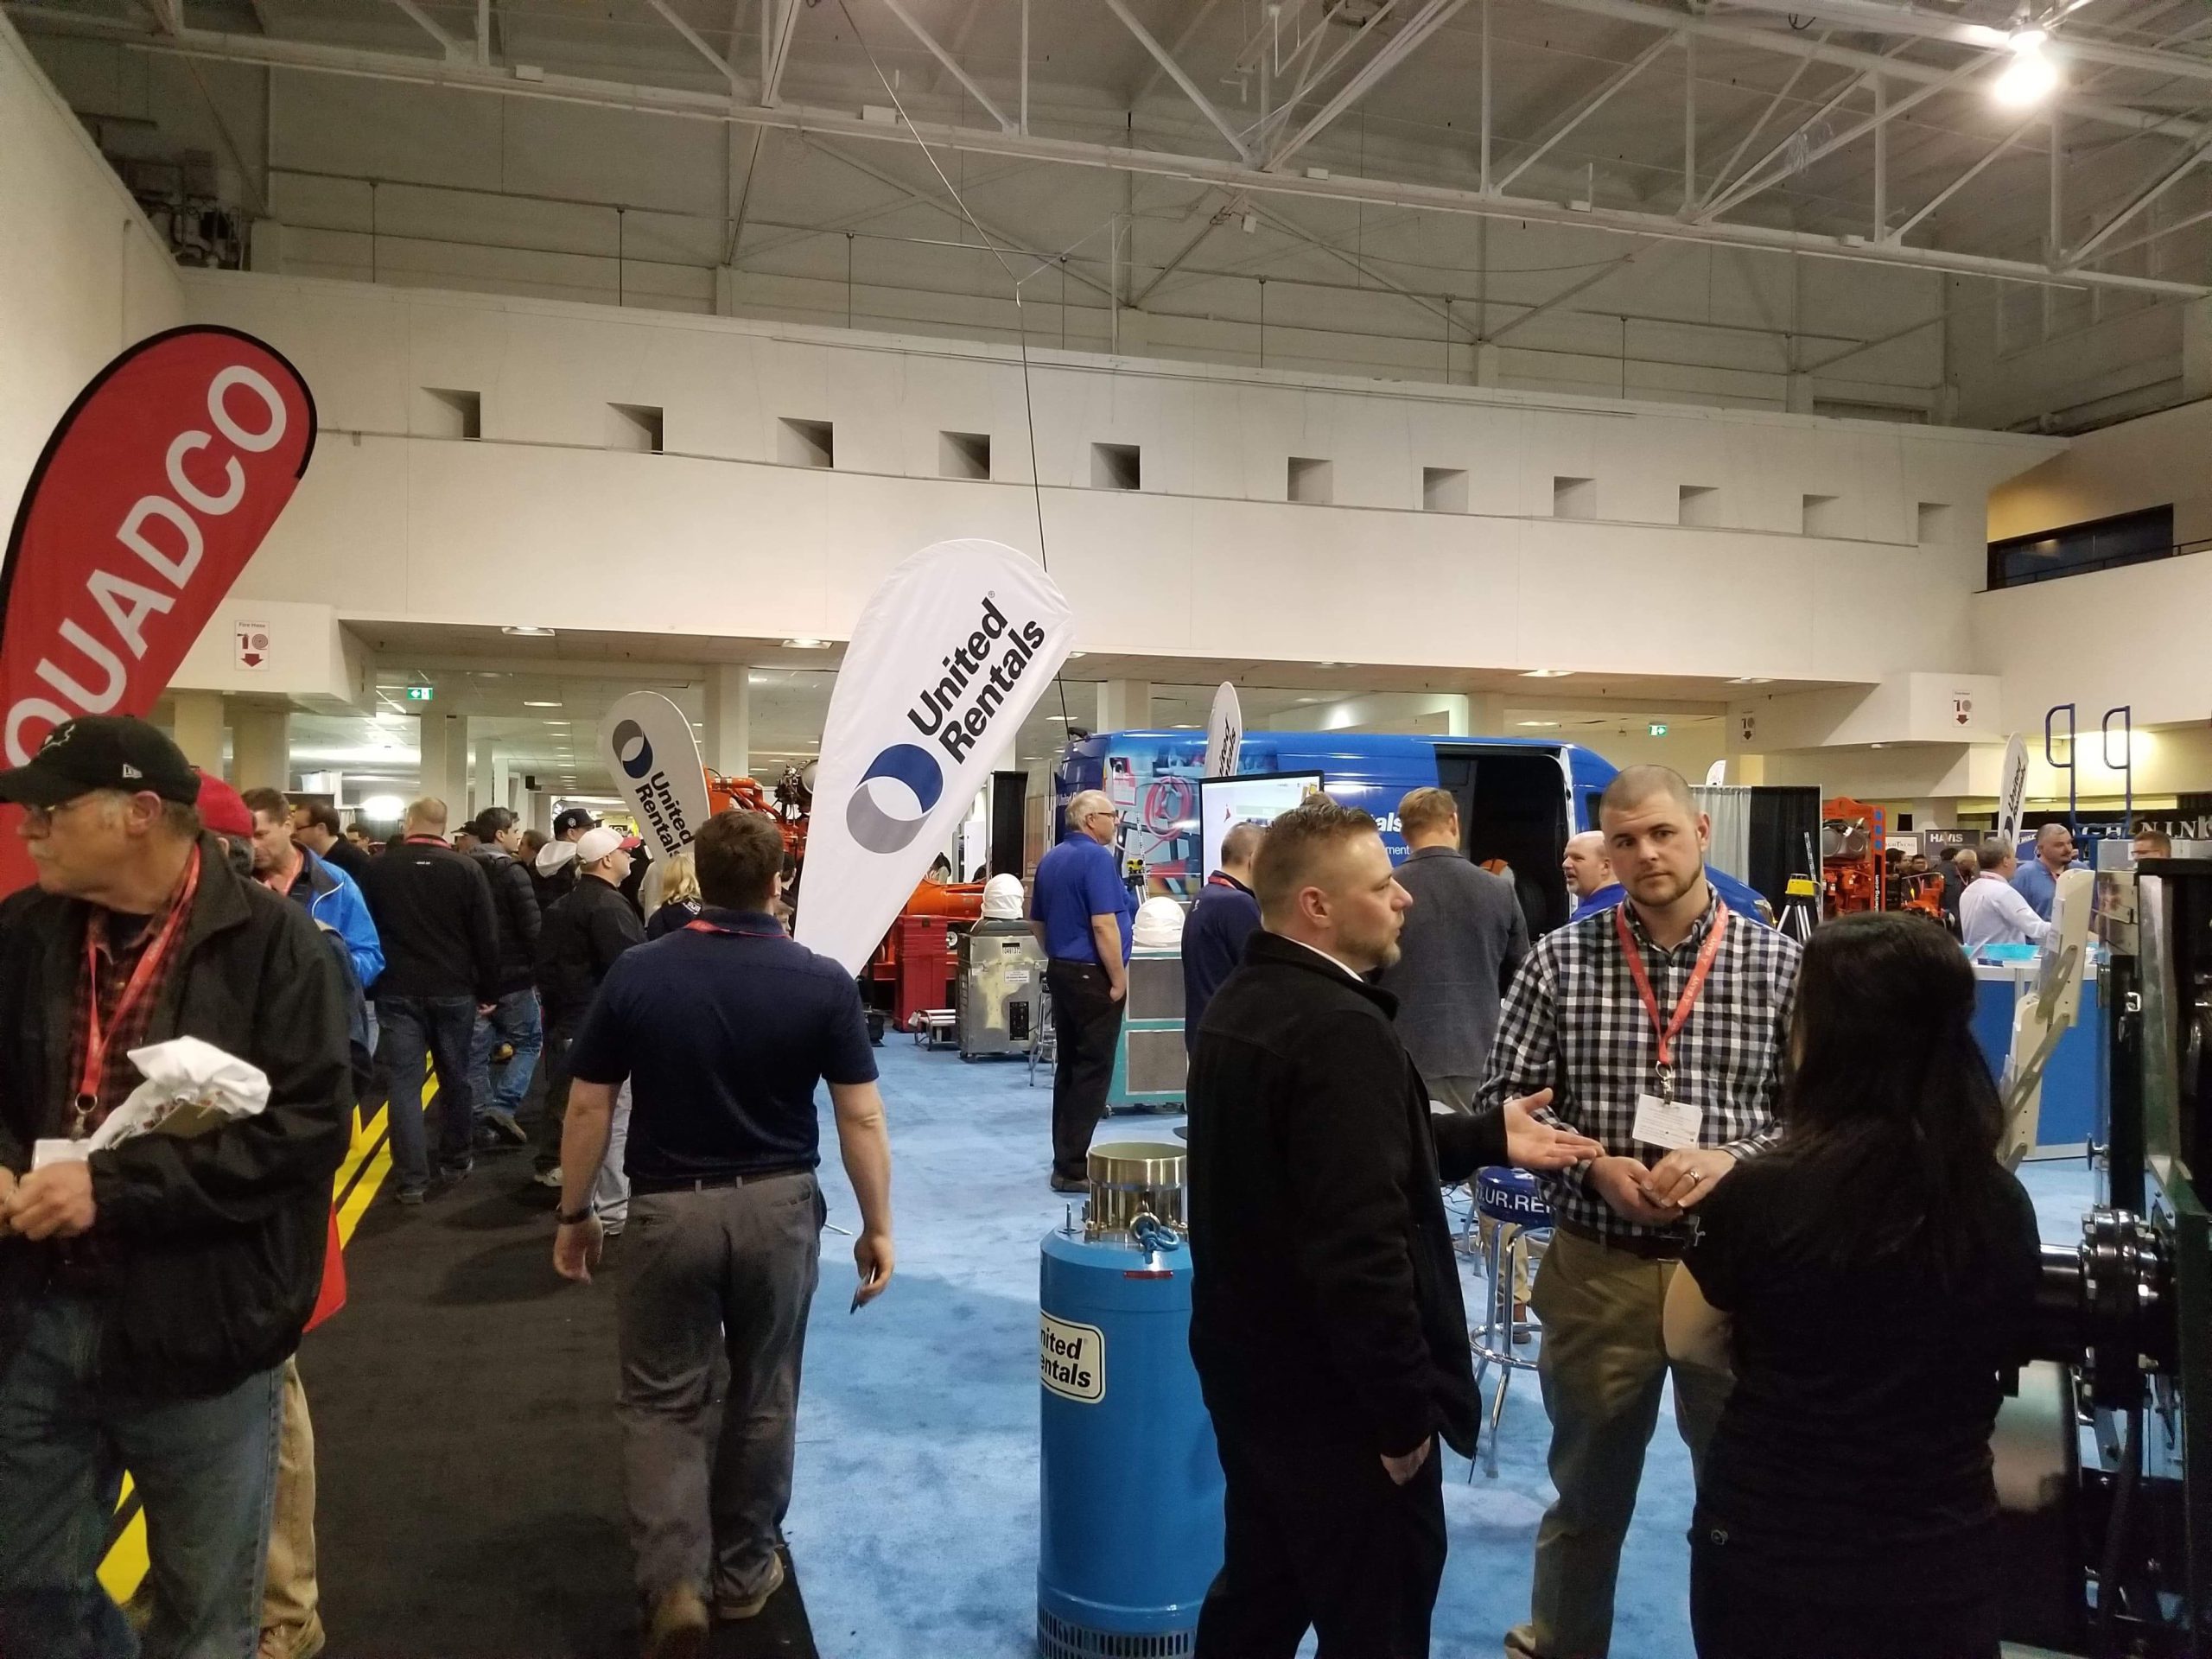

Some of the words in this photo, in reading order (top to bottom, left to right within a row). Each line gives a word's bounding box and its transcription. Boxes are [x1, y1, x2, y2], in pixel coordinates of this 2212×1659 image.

[907, 596, 1008, 736] United
[938, 620, 1045, 765] Rentals
[650, 772, 696, 845] United
[1930, 833, 1963, 842] HAVIS
